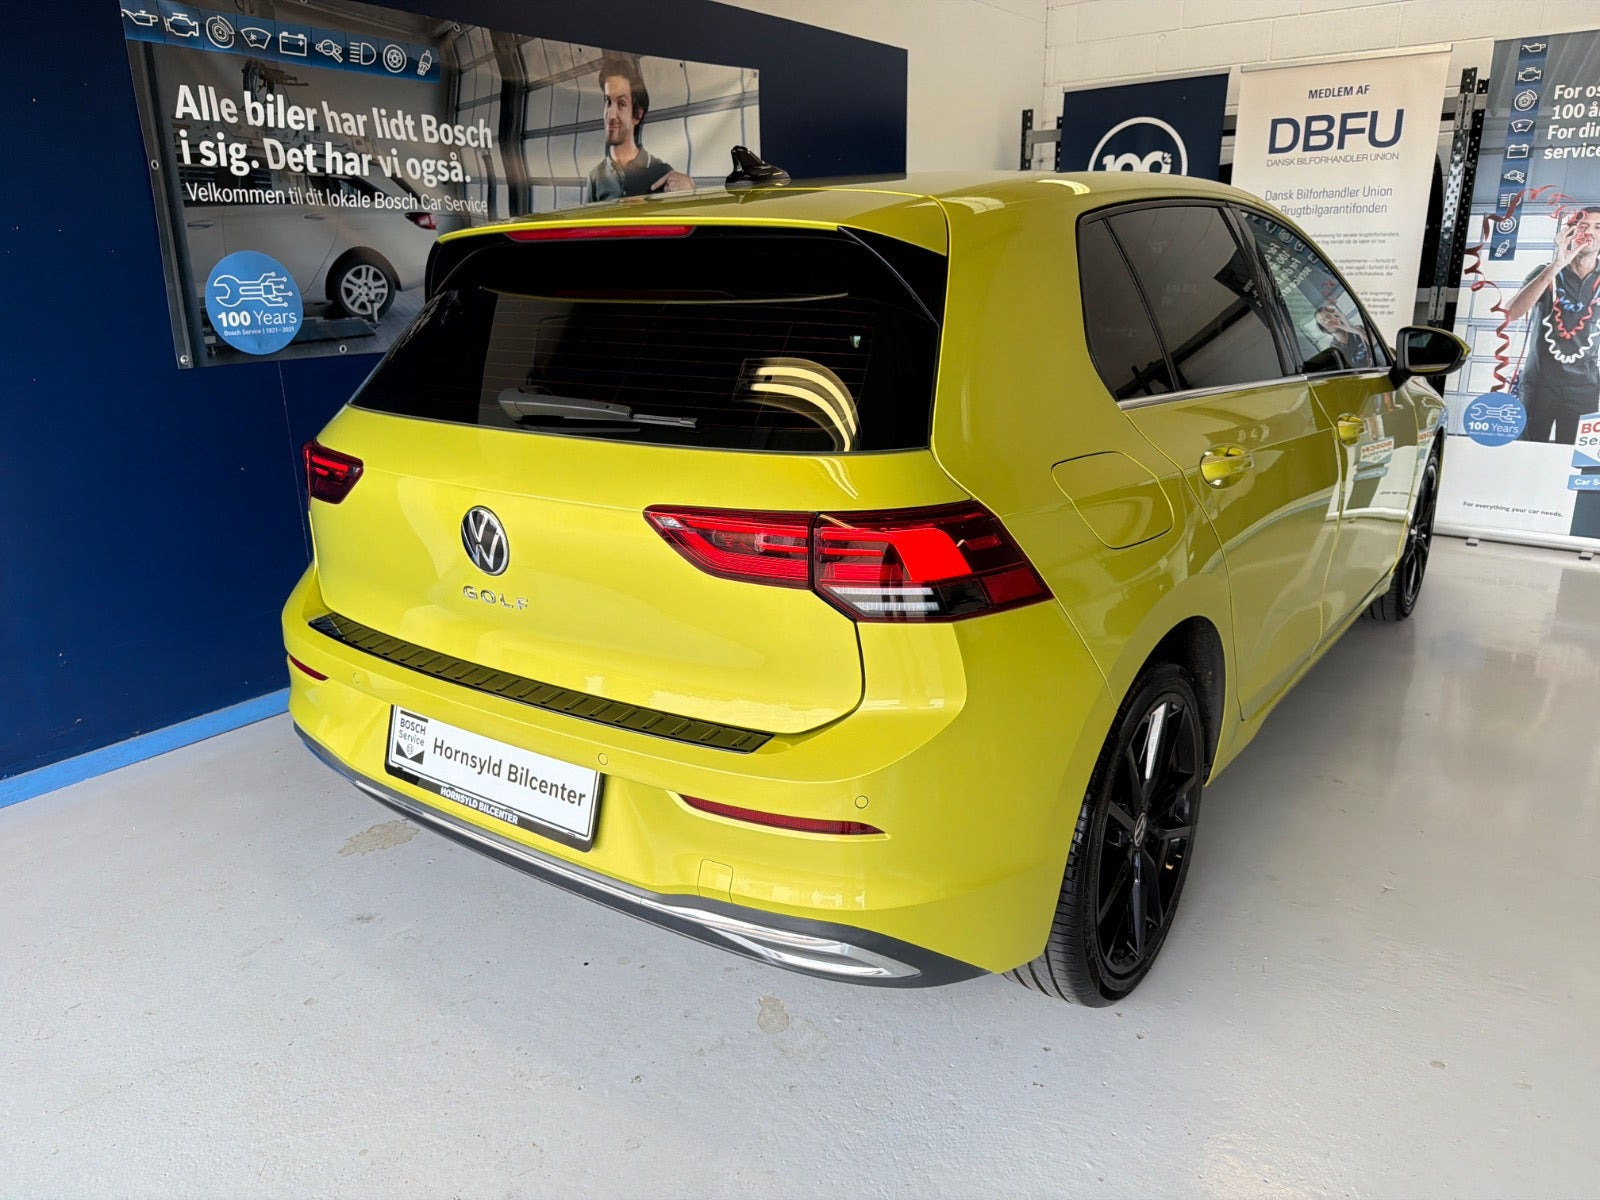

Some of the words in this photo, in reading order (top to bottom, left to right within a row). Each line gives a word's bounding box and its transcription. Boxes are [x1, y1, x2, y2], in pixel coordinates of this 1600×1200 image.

[1308, 86, 1354, 100] MEDLEM
[1356, 84, 1371, 95] AF
[1554, 84, 1583, 100] For
[175, 84, 239, 124] Alle
[243, 90, 318, 131] biler
[321, 100, 367, 137] har
[371, 106, 418, 142] lidt
[421, 113, 493, 149] Bosch
[1551, 103, 1585, 120] 100
[1268, 108, 1404, 154] DBFU
[1547, 124, 1576, 140] For
[179, 128, 192, 165] i
[199, 131, 260, 177] sig.
[263, 137, 318, 174] Det
[325, 141, 373, 177] har
[377, 147, 402, 178] vi
[406, 151, 472, 188] også.
[1266, 159, 1296, 167] DANSK
[1297, 153, 1369, 166] BILFORHANDLER
[1369, 152, 1400, 161] UNION
[185, 181, 286, 205] Velkommen
[288, 187, 304, 205] til
[305, 187, 326, 207] dit
[326, 188, 371, 208] lokale
[374, 191, 418, 210] Bosch
[420, 193, 442, 211] Car
[444, 194, 488, 213] Service
[1265, 189, 1294, 201] Dansk
[1296, 186, 1360, 200] Bilforhandler
[1362, 185, 1393, 198] Union
[217, 310, 251, 327] 100
[252, 310, 297, 325] Years
[242, 328, 261, 336] Service
[1468, 421, 1489, 431] 100
[1491, 423, 1519, 433] Years
[1578, 436, 1600, 447] Se
[1574, 478, 1591, 486] Car
[1593, 478, 1600, 486] S
[1475, 502, 1510, 512] everything
[1540, 510, 1564, 518] needs.
[463, 585, 529, 610] GOLF
[400, 718, 427, 735] BOSCH
[398, 729, 425, 746] Service
[433, 737, 502, 778] Hornsyld
[507, 763, 586, 807] Bilcenter
[440, 785, 478, 809] HORNSYLD
[479, 801, 519, 825] BILCENTER
